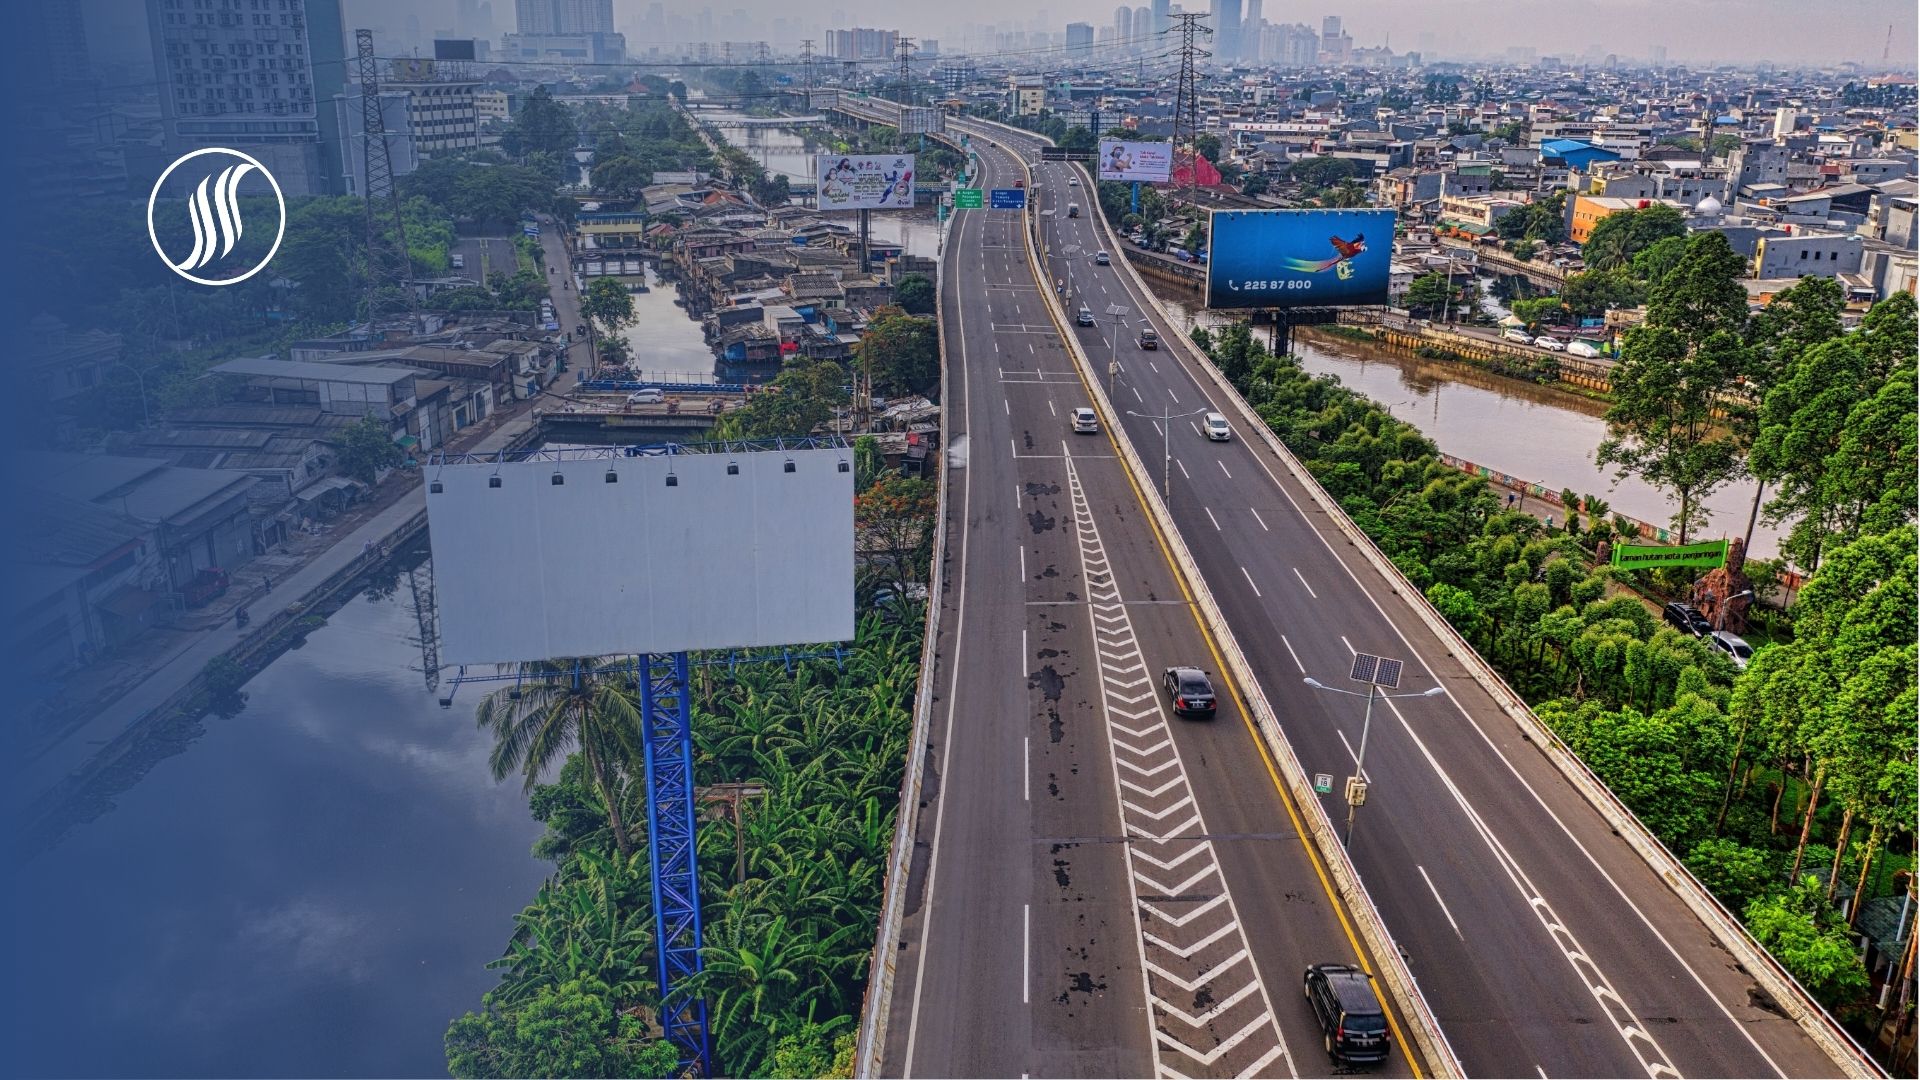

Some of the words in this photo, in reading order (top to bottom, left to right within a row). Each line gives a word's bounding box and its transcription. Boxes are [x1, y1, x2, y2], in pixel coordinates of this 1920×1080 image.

[1244, 281, 1267, 290] 225
[1270, 281, 1285, 289] 87
[1287, 280, 1312, 289] 800
